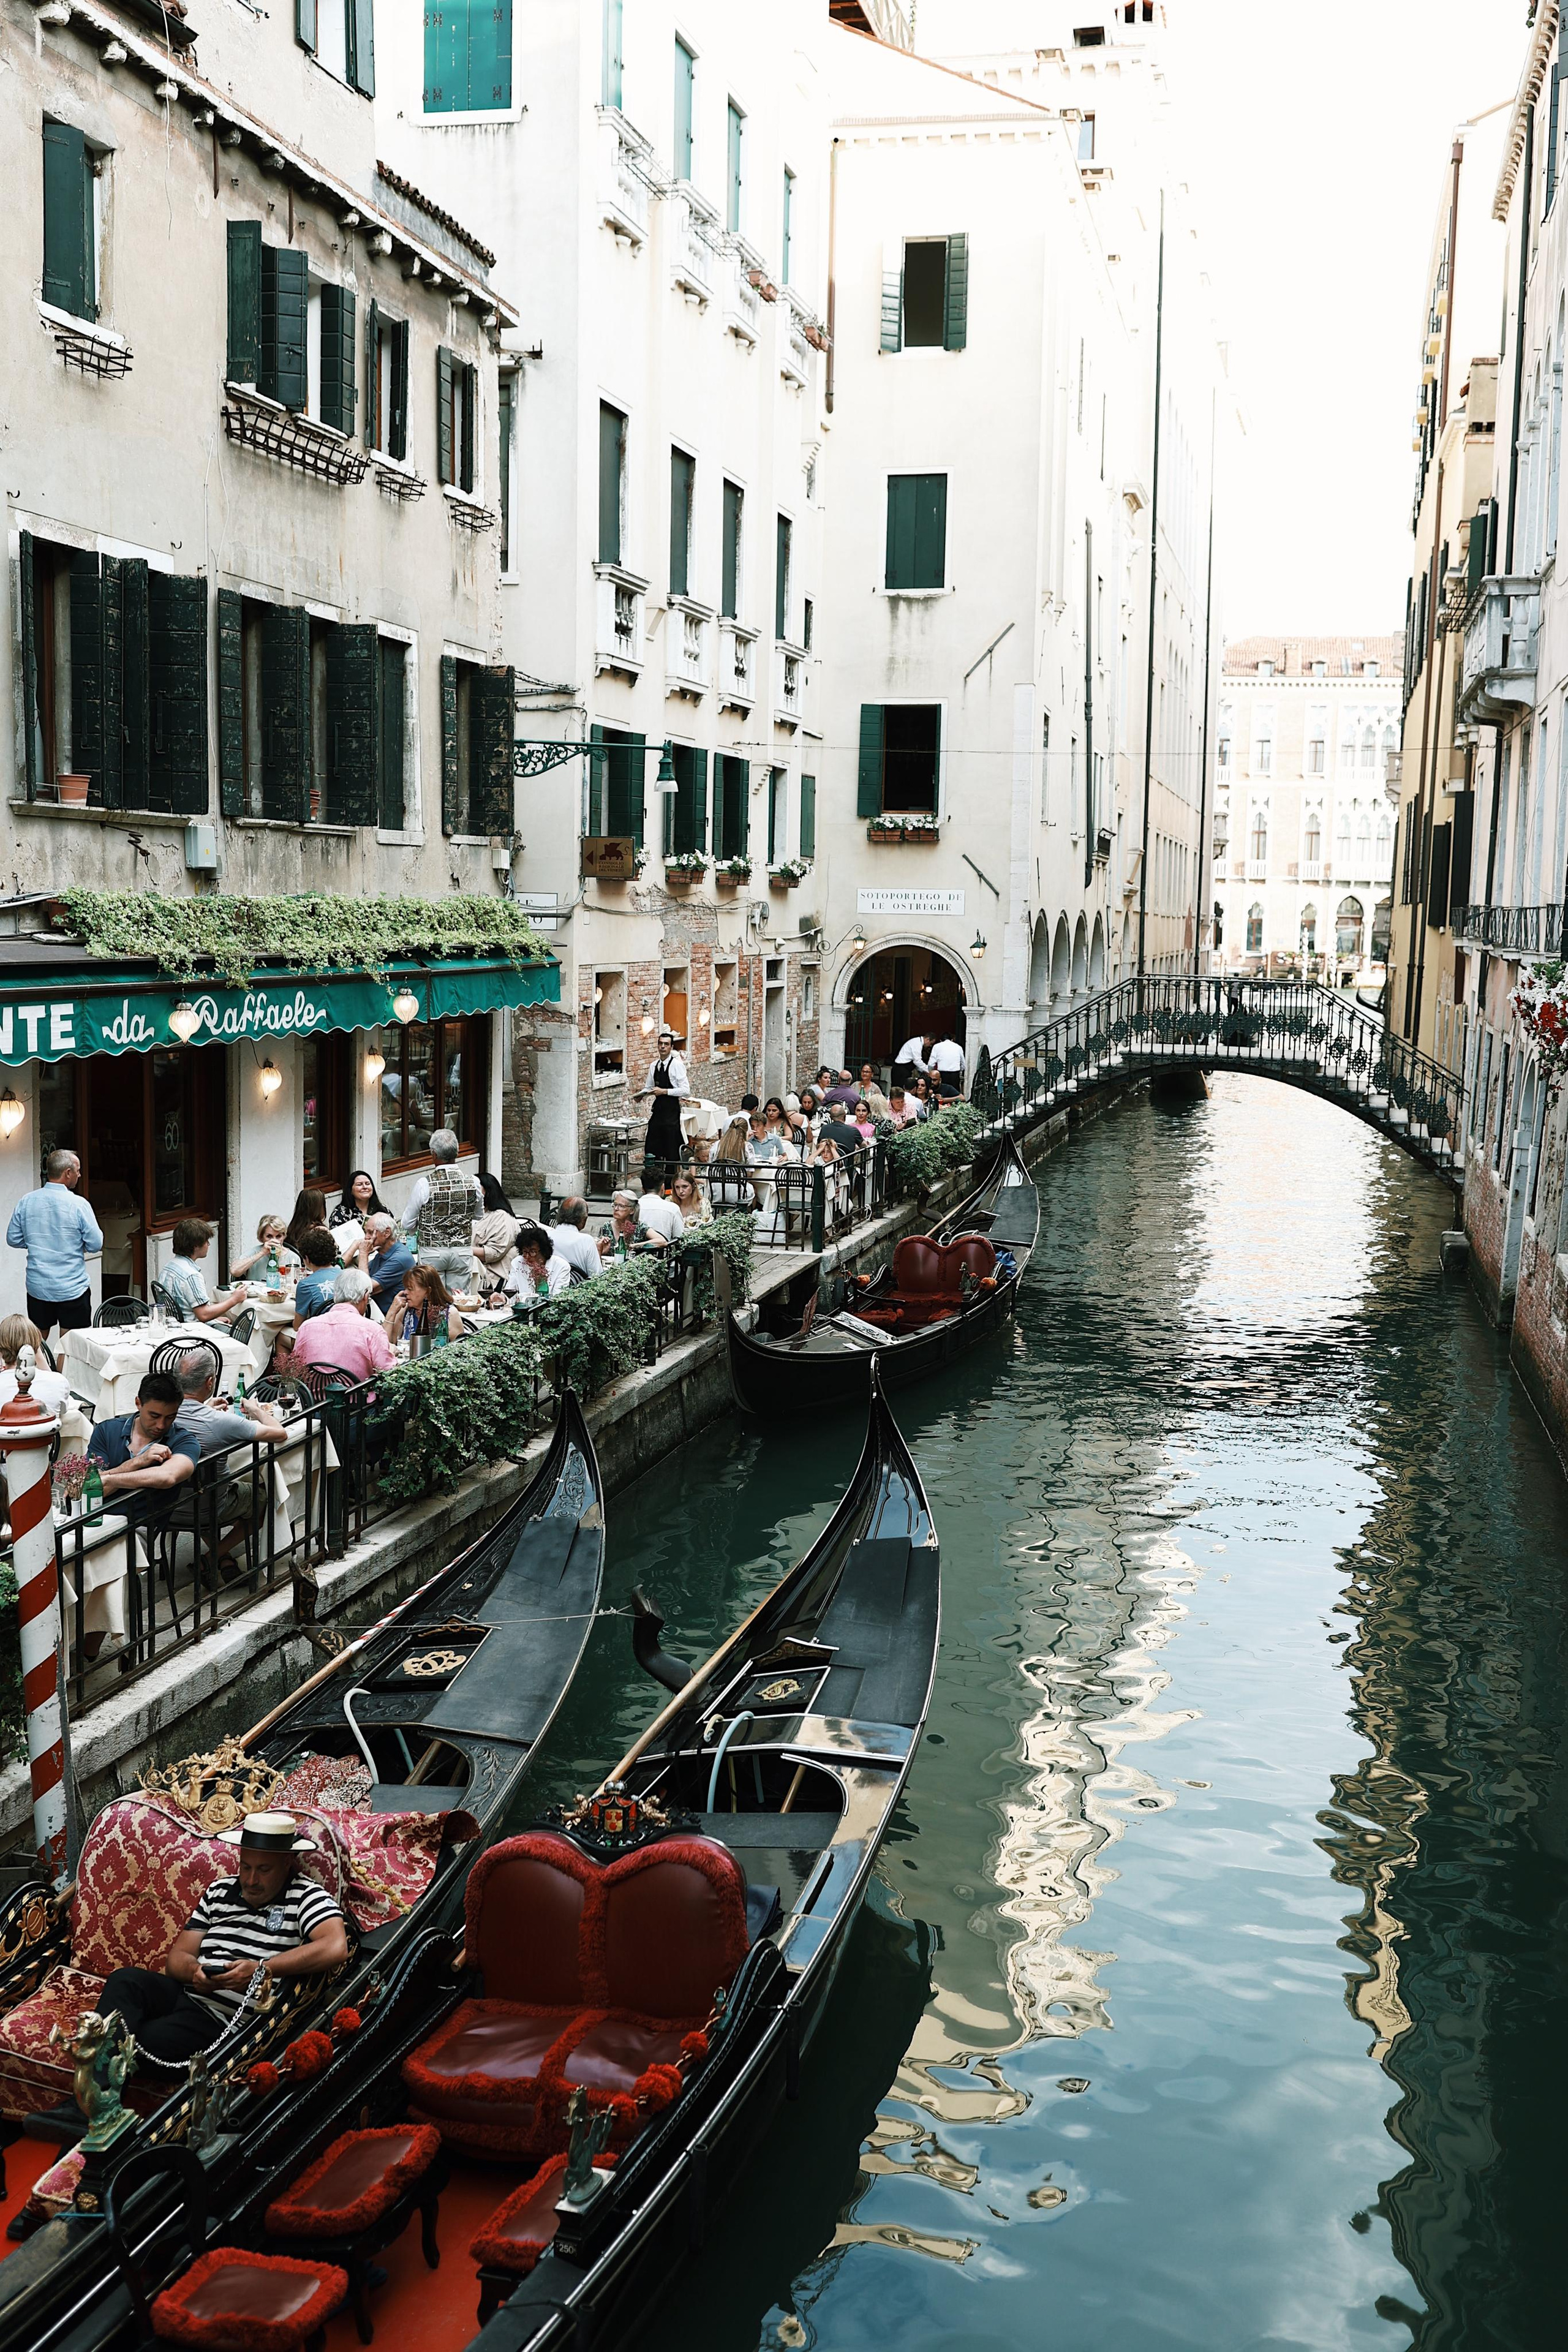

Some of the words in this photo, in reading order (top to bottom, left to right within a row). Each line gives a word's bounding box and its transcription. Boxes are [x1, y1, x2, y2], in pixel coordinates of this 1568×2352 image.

[892, 902, 951, 911] OSTREGHE
[102, 999, 155, 1044] da
[190, 990, 326, 1036] Raffaele
[165, 1122, 179, 1151] 60
[559, 2244, 574, 2254] 250
